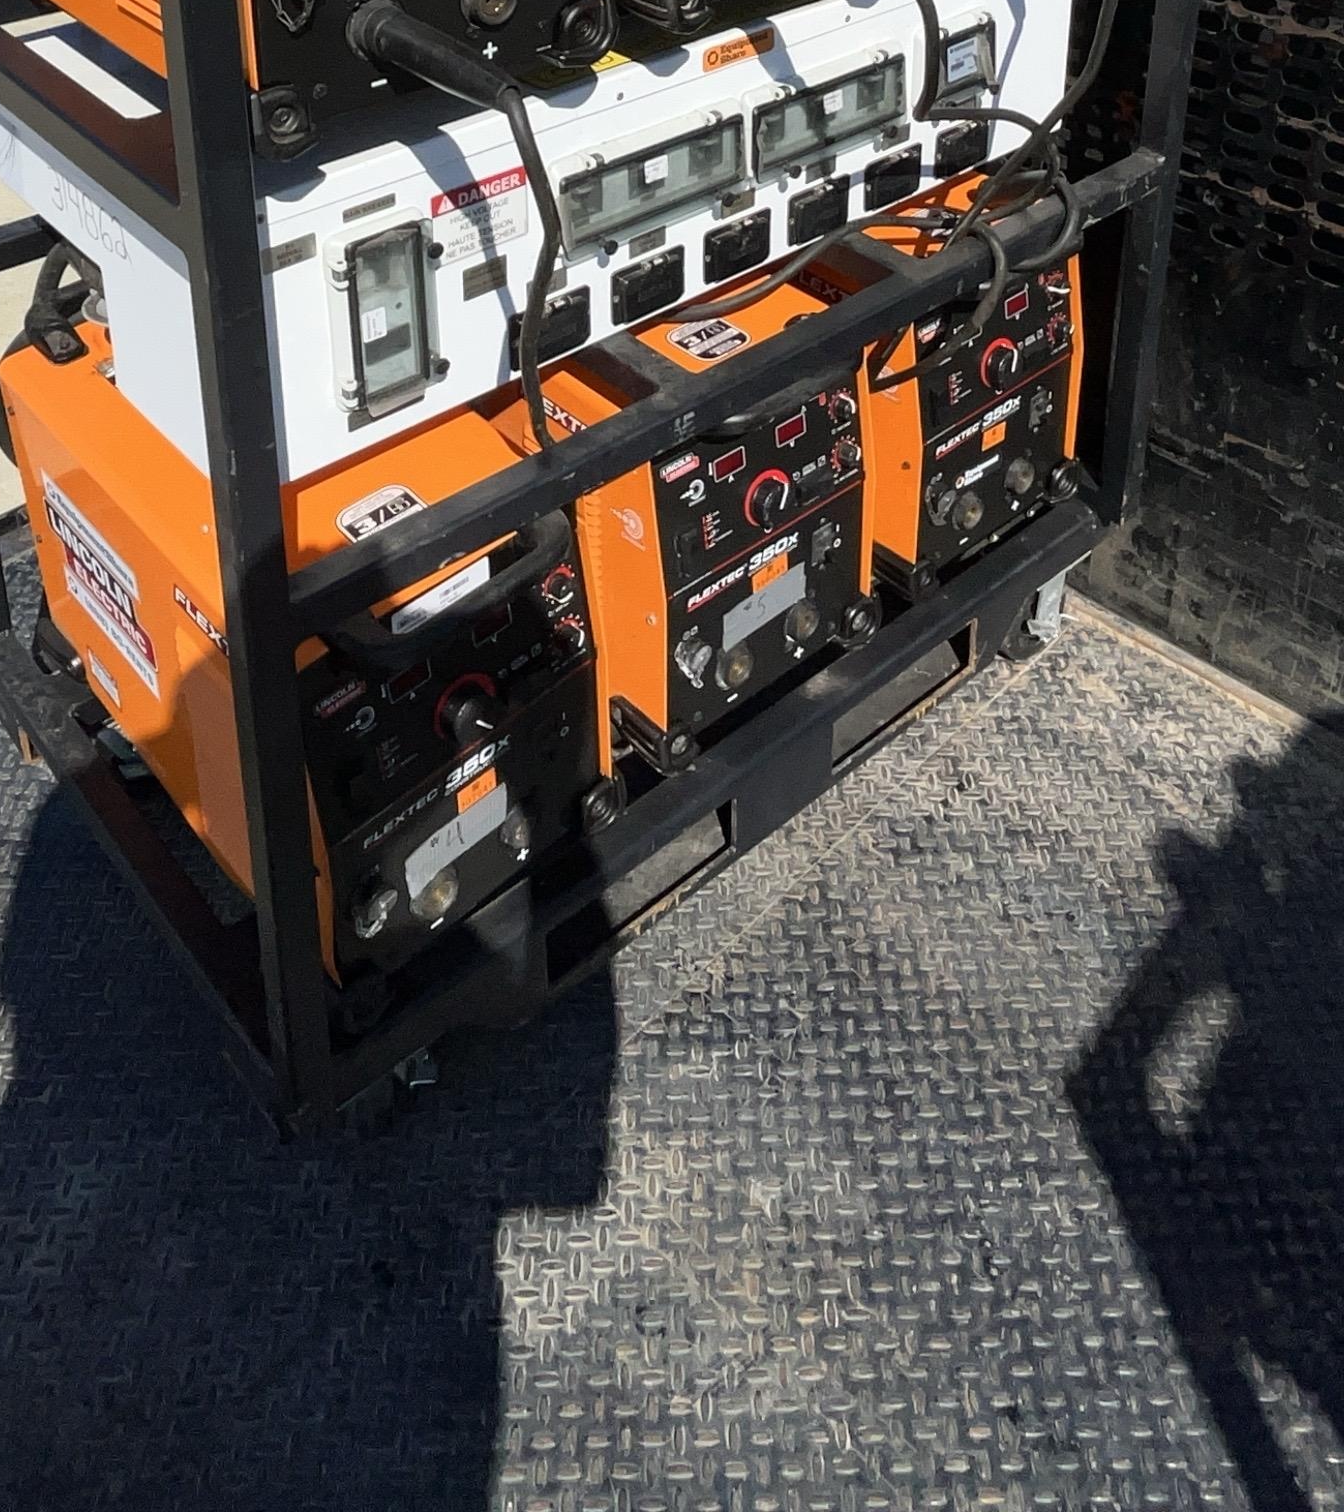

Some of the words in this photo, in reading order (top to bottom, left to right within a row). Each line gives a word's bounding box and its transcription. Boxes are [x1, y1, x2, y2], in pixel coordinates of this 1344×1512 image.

[457, 172, 521, 206] DANGER
[49, 507, 133, 618] LINCOLN
[73, 560, 147, 655] ELECTRIC
[363, 788, 440, 850] FLEXTEC
